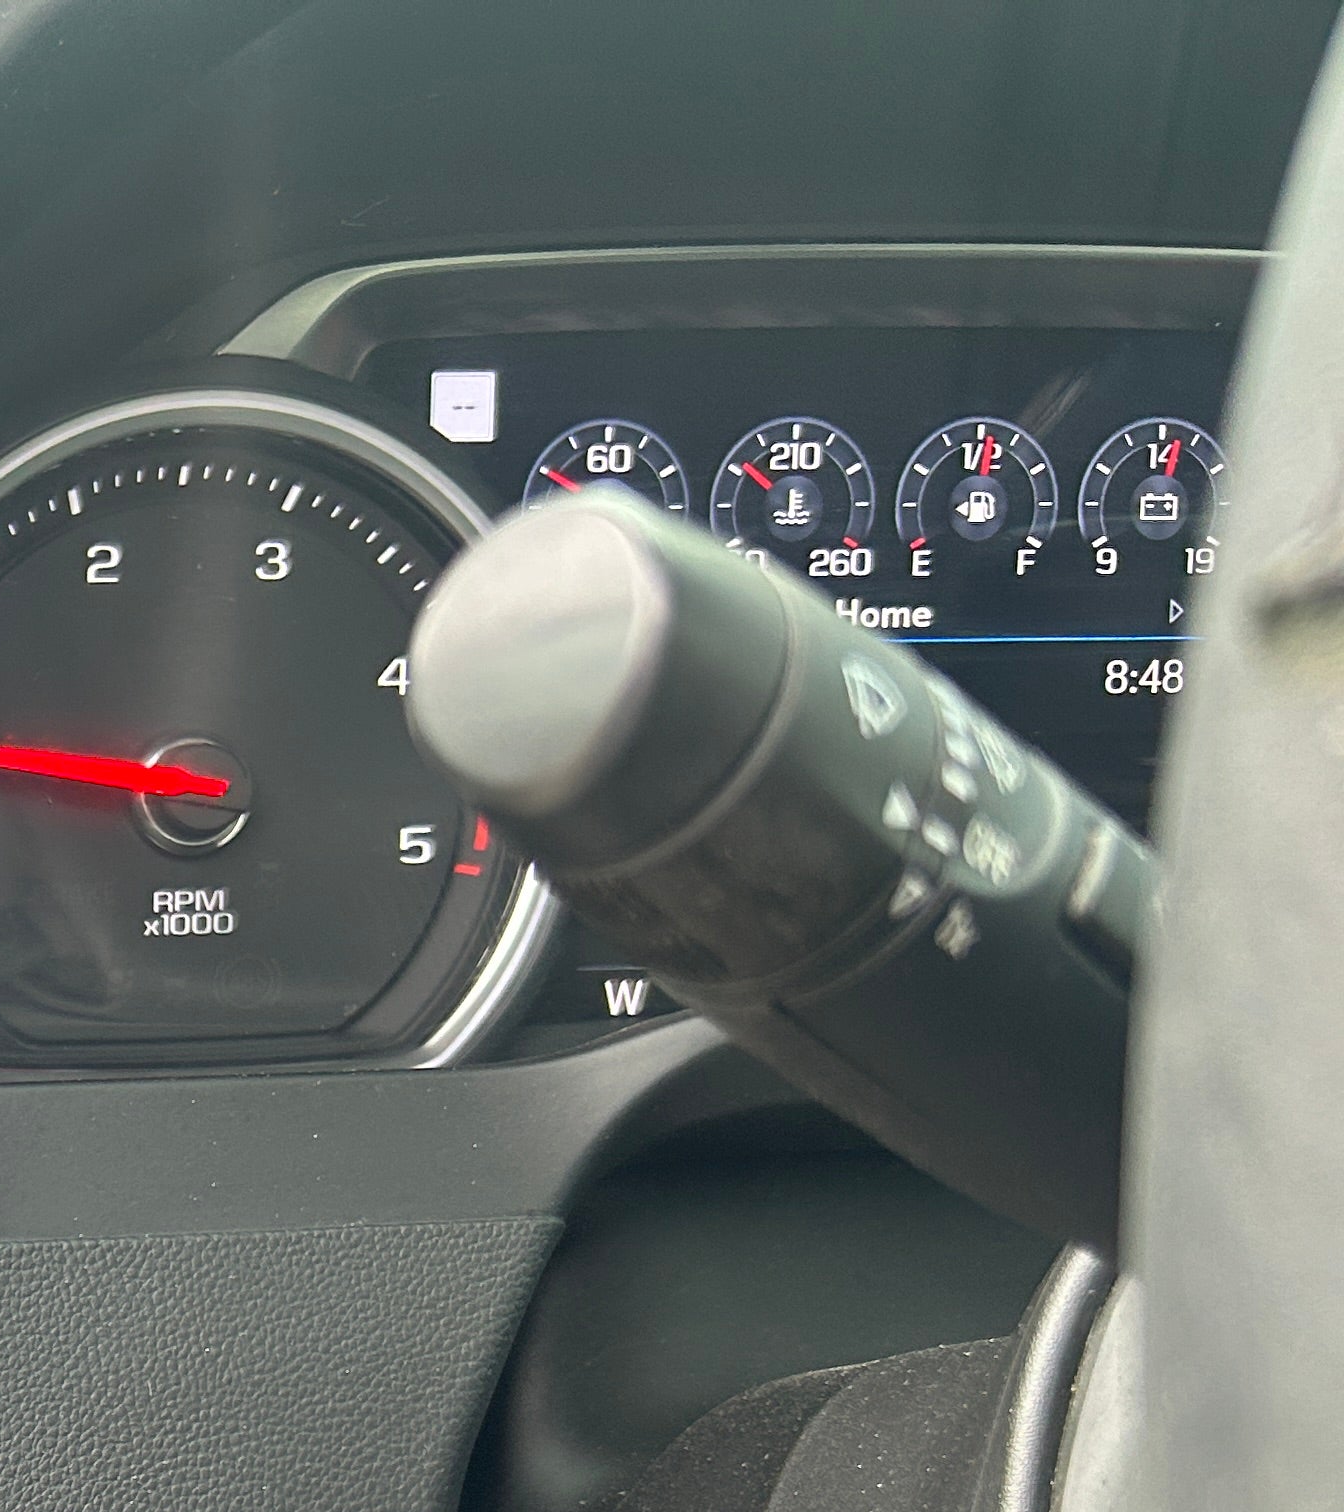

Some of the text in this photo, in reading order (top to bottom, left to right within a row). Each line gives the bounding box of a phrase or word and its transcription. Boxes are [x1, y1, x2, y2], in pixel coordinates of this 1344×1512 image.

[586, 443, 633, 474] 60
[769, 441, 822, 471] 210
[86, 543, 124, 584] 2
[254, 540, 293, 582] 3
[808, 548, 873, 577] 260
[911, 549, 933, 577] E
[1015, 548, 1038, 576] F
[1095, 547, 1119, 576] 9
[1184, 547, 1216, 575] 19
[835, 598, 934, 629] Home
[376, 655, 411, 697] 4
[1103, 658, 1185, 695] 8:48
[398, 824, 437, 865] 5
[152, 889, 227, 914] RPM
[142, 912, 235, 937] x1000
[603, 979, 646, 1016] W
